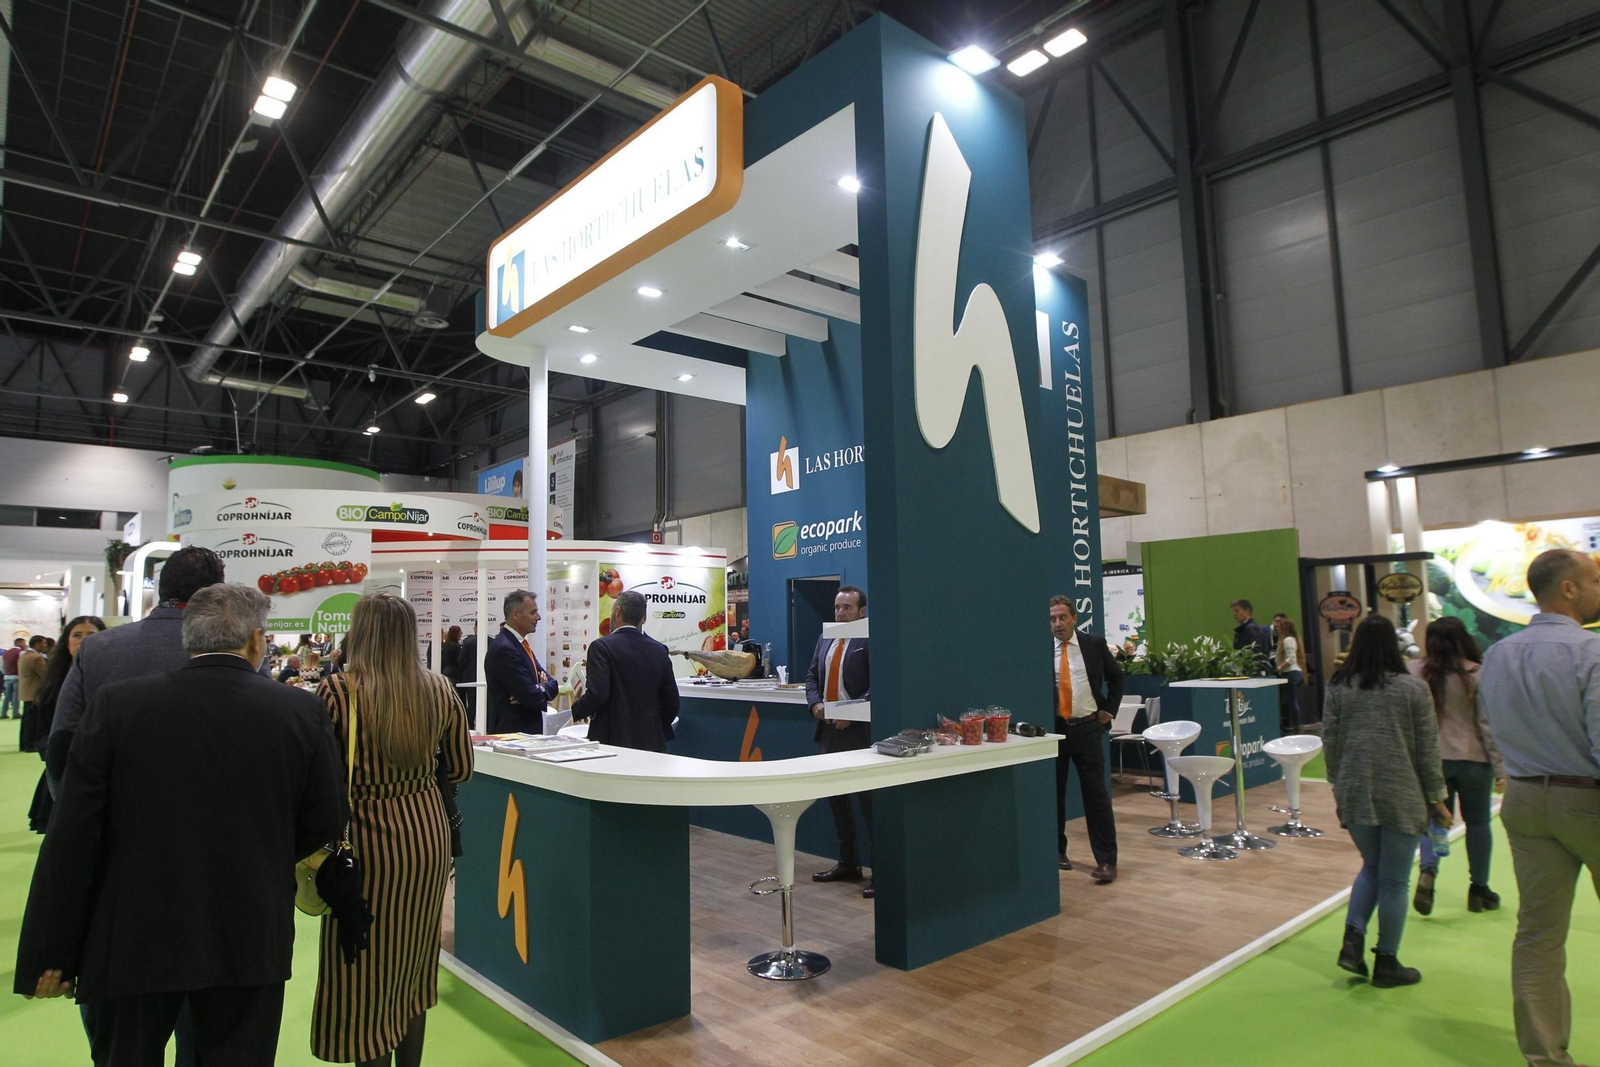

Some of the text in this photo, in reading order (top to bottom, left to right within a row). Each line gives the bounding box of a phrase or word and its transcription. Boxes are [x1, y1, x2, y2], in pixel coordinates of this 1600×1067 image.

[805, 452, 831, 474] LAS
[833, 444, 865, 467] HOR
[1062, 320, 1093, 636] AS HORTICHUELAS
[216, 510, 292, 522] COPROHNÍJAR
[340, 507, 365, 520] BIO
[487, 507, 504, 519] BIO
[800, 510, 863, 541] ecopark
[800, 538, 862, 557] organic produce
[645, 591, 706, 604] PROHNÍJAR
